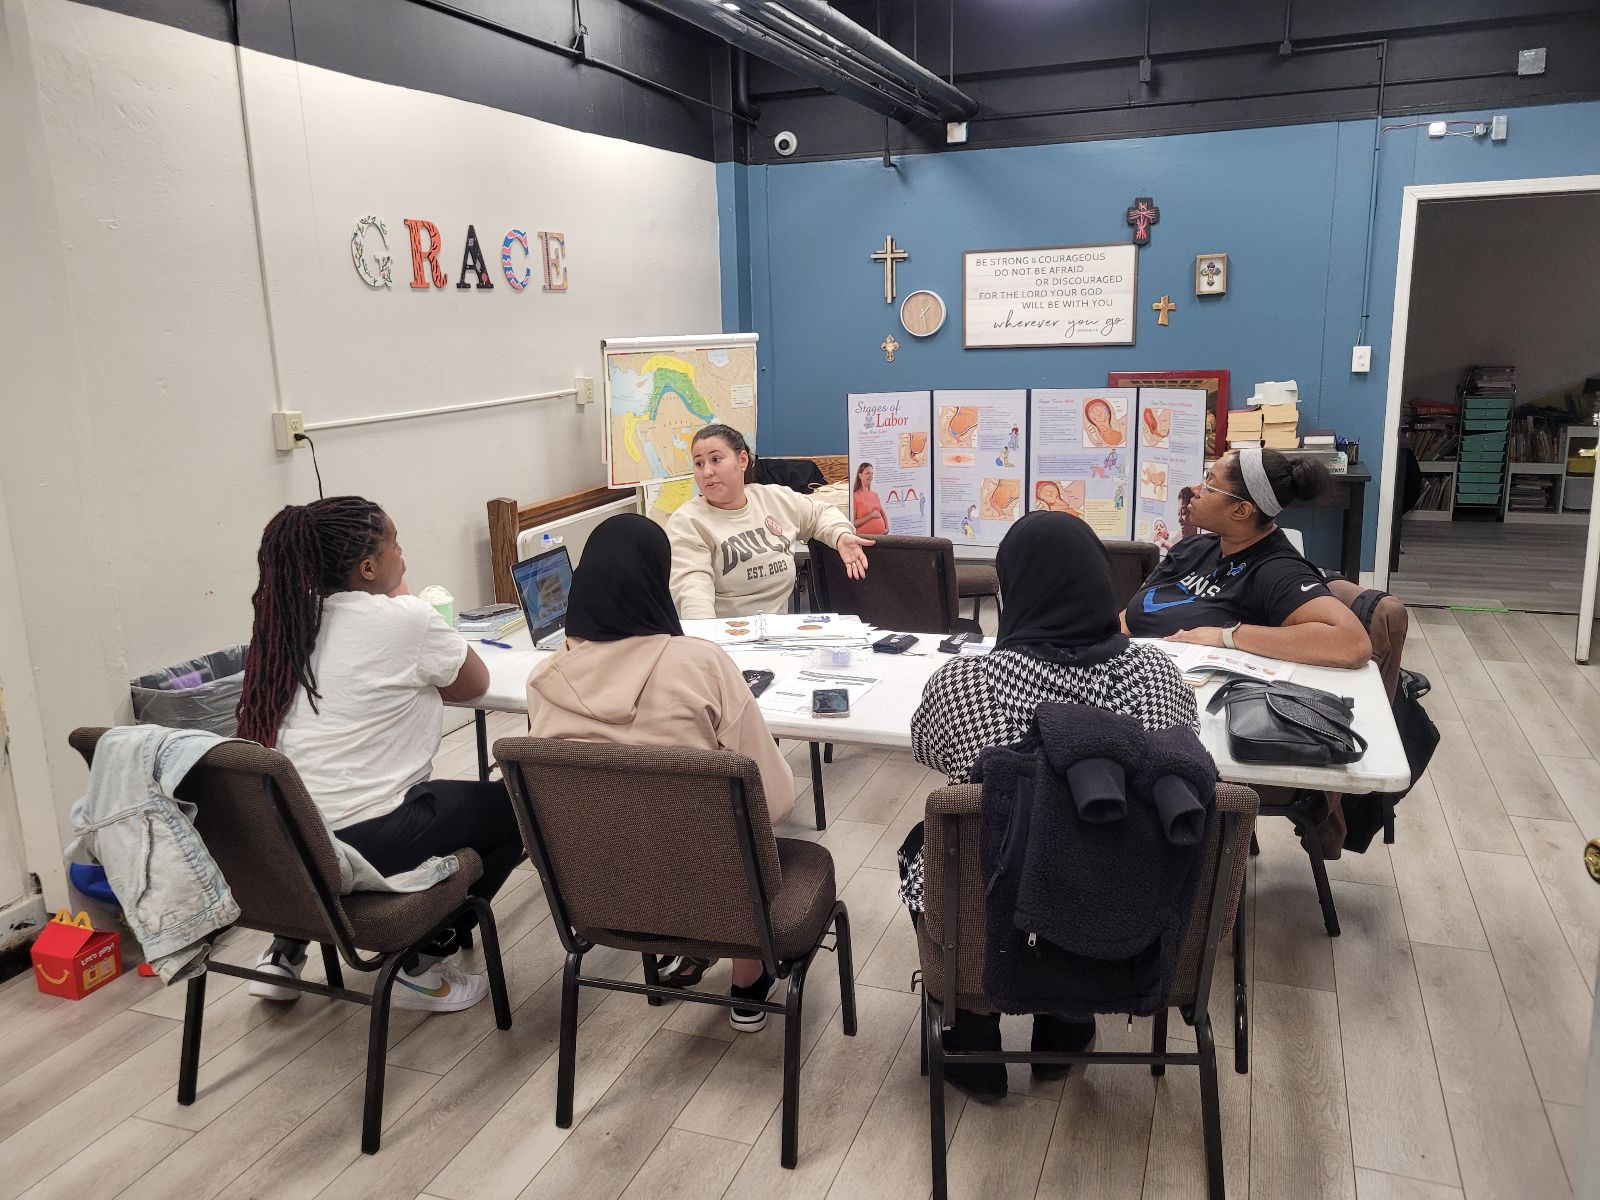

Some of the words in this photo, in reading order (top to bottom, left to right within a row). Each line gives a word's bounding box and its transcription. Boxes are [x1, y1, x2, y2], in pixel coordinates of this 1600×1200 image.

[351, 215, 568, 291] GRACE
[976, 258, 988, 267] BE
[990, 256, 1029, 266] STRONG
[1038, 252, 1106, 264] COURAGEOUS
[994, 268, 1009, 277] DO
[1011, 267, 1032, 276] NOT
[1034, 266, 1047, 275] BE
[1049, 265, 1084, 275] AFRAID
[1035, 278, 1049, 287] OR
[1052, 274, 1123, 286] DISCOURAGED
[979, 291, 998, 301] FOR
[1000, 290, 1020, 299] THE
[1021, 289, 1048, 298] LORD
[1050, 288, 1077, 297] YOUR
[1080, 287, 1103, 296] GOD
[1022, 301, 1045, 310] WILL
[1047, 300, 1060, 309] BE
[1062, 299, 1089, 308] WITH
[1091, 298, 1113, 307] YOU
[993, 309, 1060, 329] wherever
[1064, 318, 1099, 339] you
[1100, 316, 1125, 337] go
[855, 400, 888, 417] Stages
[889, 399, 900, 415] of
[876, 412, 909, 428] Labor
[746, 565, 767, 581] EST.
[769, 559, 788, 575] 2023
